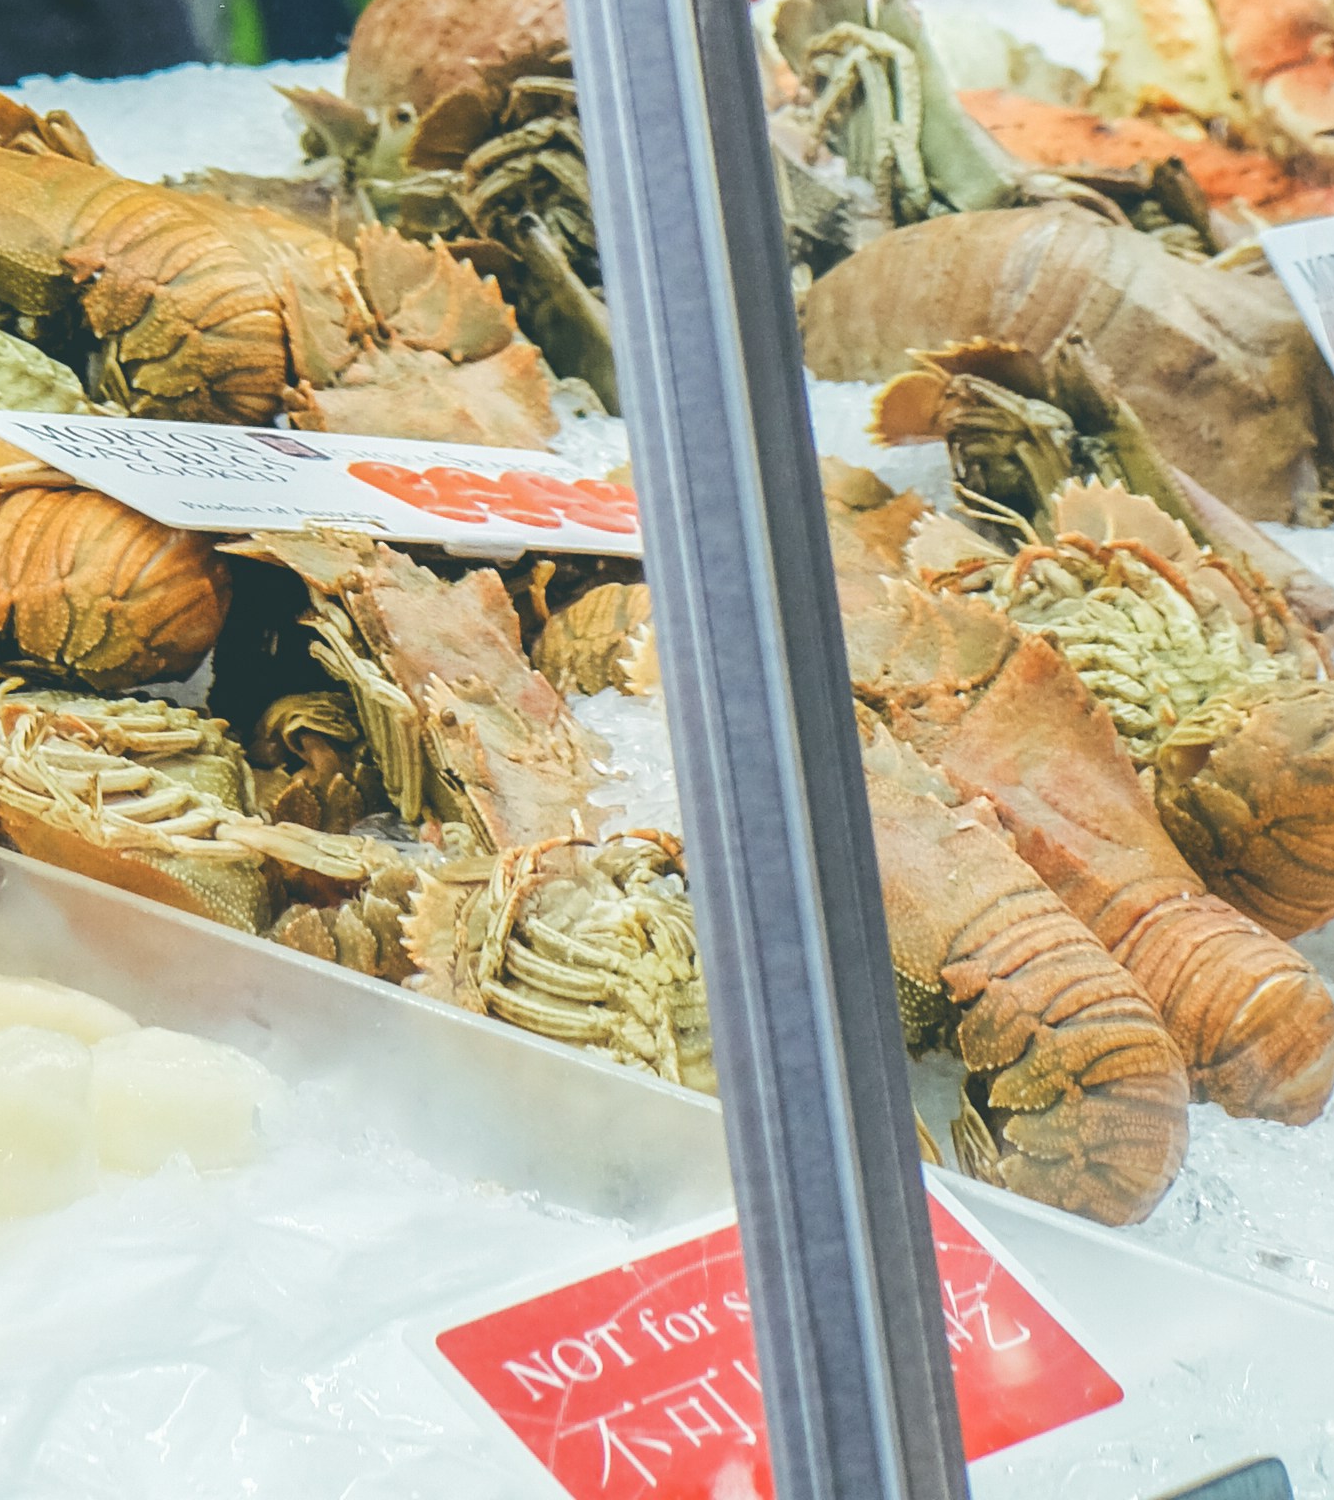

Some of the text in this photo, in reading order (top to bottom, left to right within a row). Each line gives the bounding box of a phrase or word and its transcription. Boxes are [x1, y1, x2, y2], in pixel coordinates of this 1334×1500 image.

[13, 421, 263, 454] MORTON
[55, 443, 297, 472] BAY BUGS
[125, 463, 289, 483] COOKED
[178, 500, 264, 513] Product
[266, 505, 292, 515] of
[501, 1319, 635, 1402] NOT
[639, 1303, 718, 1352] for
